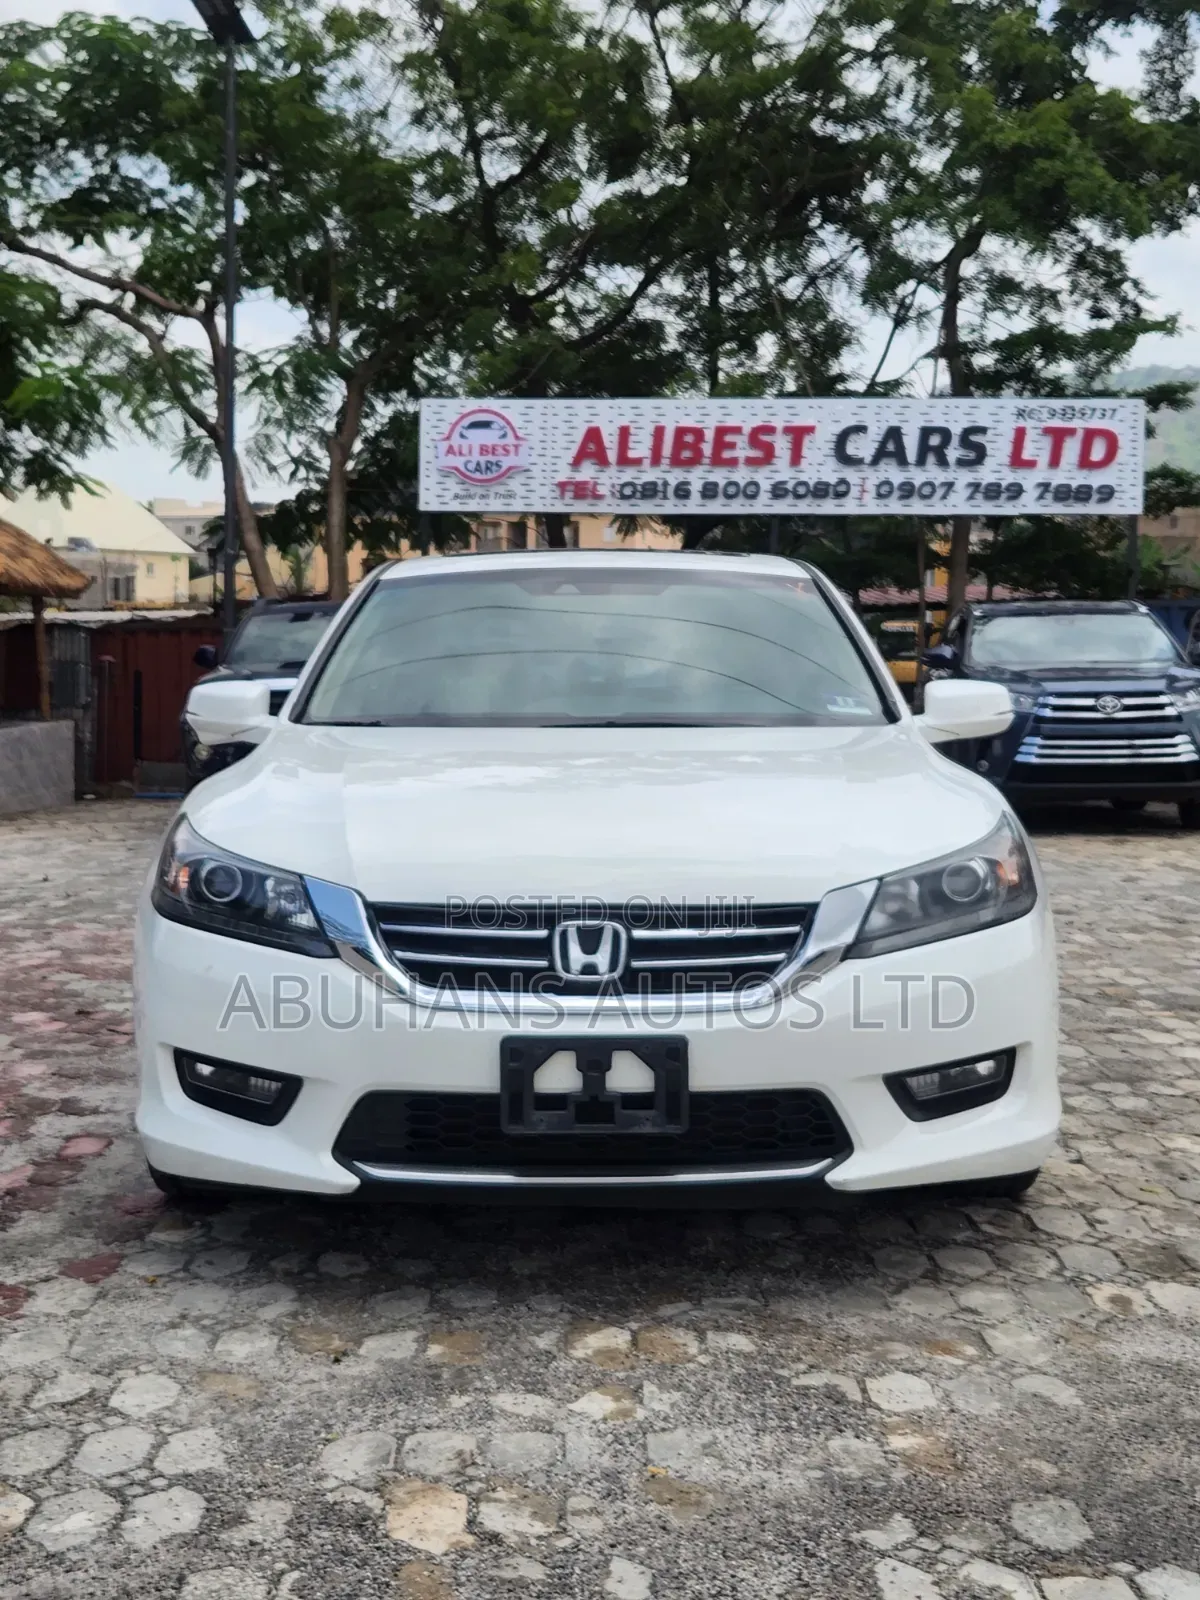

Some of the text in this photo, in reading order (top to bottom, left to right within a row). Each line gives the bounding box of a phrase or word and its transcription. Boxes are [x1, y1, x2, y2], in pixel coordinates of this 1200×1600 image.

[444, 443, 522, 457] ALI BEST
[571, 425, 1119, 469] ALIBEST CARS LTD
[463, 460, 503, 475] CARS
[620, 480, 692, 500] 0816
[701, 480, 761, 500] 800
[771, 480, 851, 500] 6080
[875, 480, 955, 501] 0907
[964, 482, 1024, 501] 789
[1034, 482, 1116, 503] 7889
